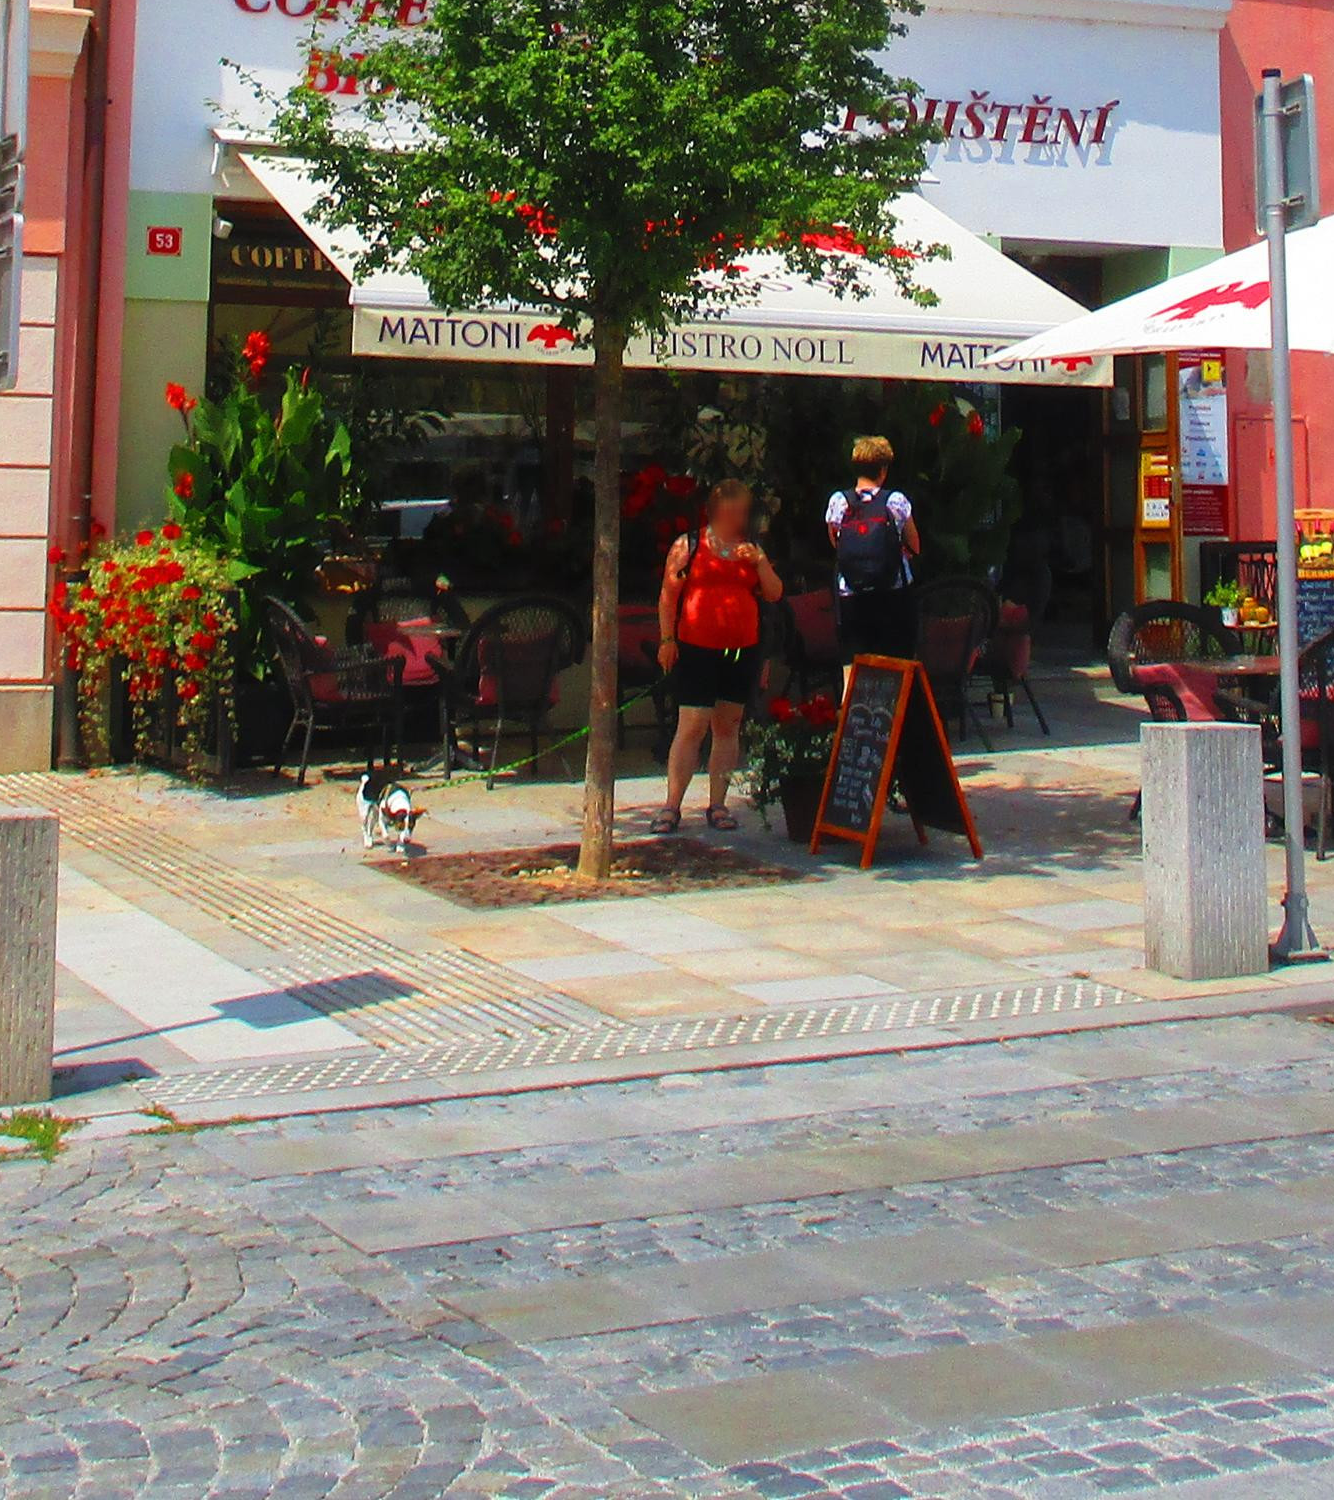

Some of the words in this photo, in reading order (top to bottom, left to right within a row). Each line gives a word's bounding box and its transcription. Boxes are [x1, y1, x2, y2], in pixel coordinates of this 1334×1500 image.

[155, 233, 174, 249] 53
[378, 315, 522, 350] MATTONI
[649, 330, 762, 361] BISTRO
[770, 336, 855, 365] NOLL
